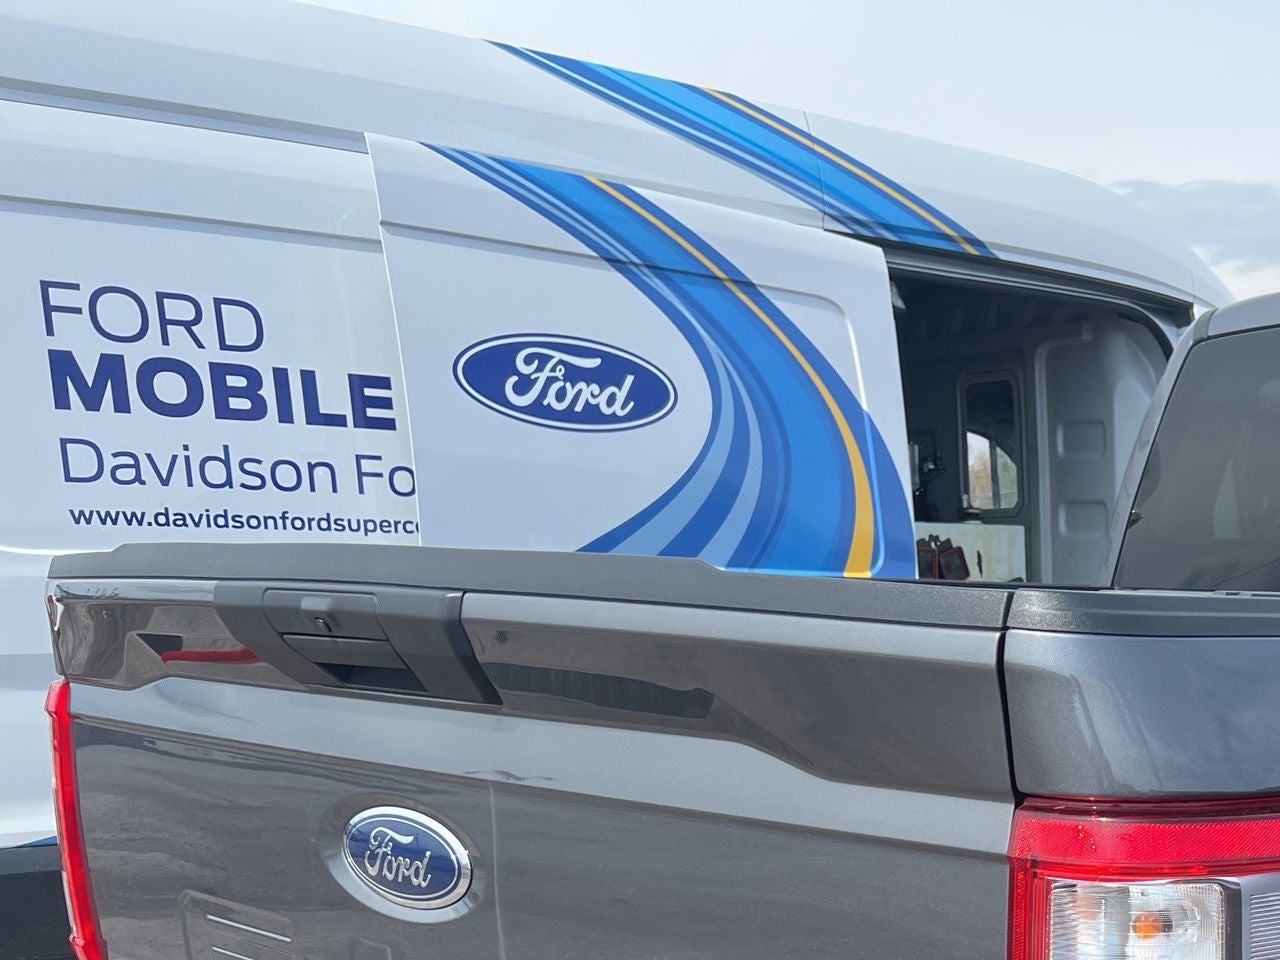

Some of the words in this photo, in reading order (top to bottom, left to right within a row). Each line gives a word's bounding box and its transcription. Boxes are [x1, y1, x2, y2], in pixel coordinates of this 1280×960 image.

[38, 279, 264, 352] FORD
[47, 349, 398, 431] MOBILE
[504, 346, 635, 418] Ford
[58, 437, 339, 495] Davidson
[68, 507, 419, 537] www.davidsonfordsuperc
[364, 826, 432, 889] Ford
